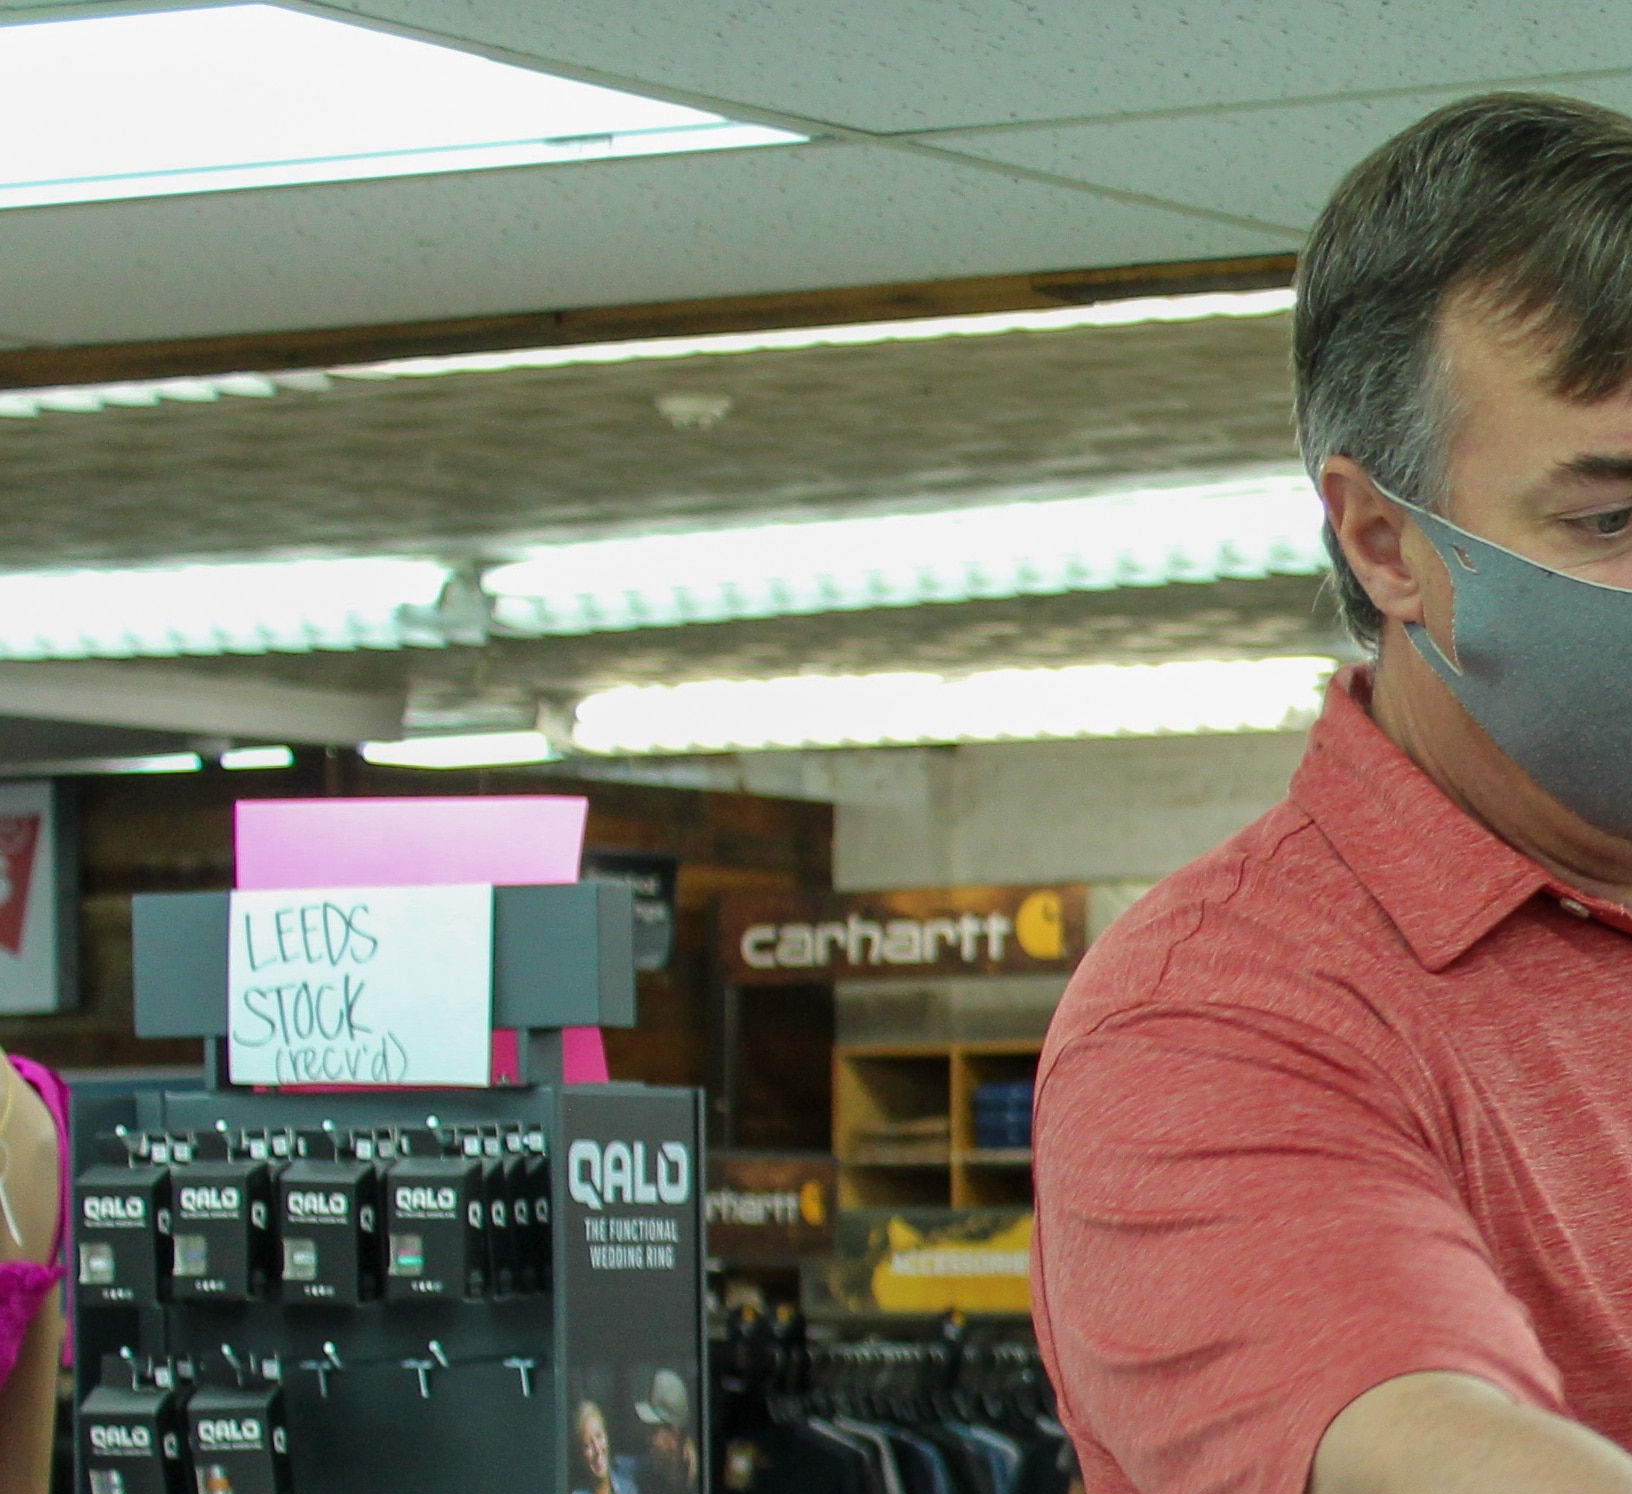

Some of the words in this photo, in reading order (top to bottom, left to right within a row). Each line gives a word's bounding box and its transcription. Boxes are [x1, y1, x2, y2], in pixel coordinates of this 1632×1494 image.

[243, 903, 380, 972] LEEDS
[740, 910, 1013, 970] carhartt
[232, 981, 367, 1047] STOCK
[568, 1138, 692, 1210] QALO
[83, 1196, 145, 1221] QALO
[180, 1187, 240, 1212] QALO
[287, 1192, 349, 1216] QALO
[395, 1187, 457, 1212] QALO
[706, 1188, 800, 1225] rhartt
[585, 1217, 607, 1241] THE
[609, 1218, 678, 1243] FUNCTIONAL
[590, 1244, 644, 1270] WEDDING
[646, 1246, 675, 1269] RING
[90, 1425, 150, 1449] QALO
[198, 1419, 261, 1442] QALO
